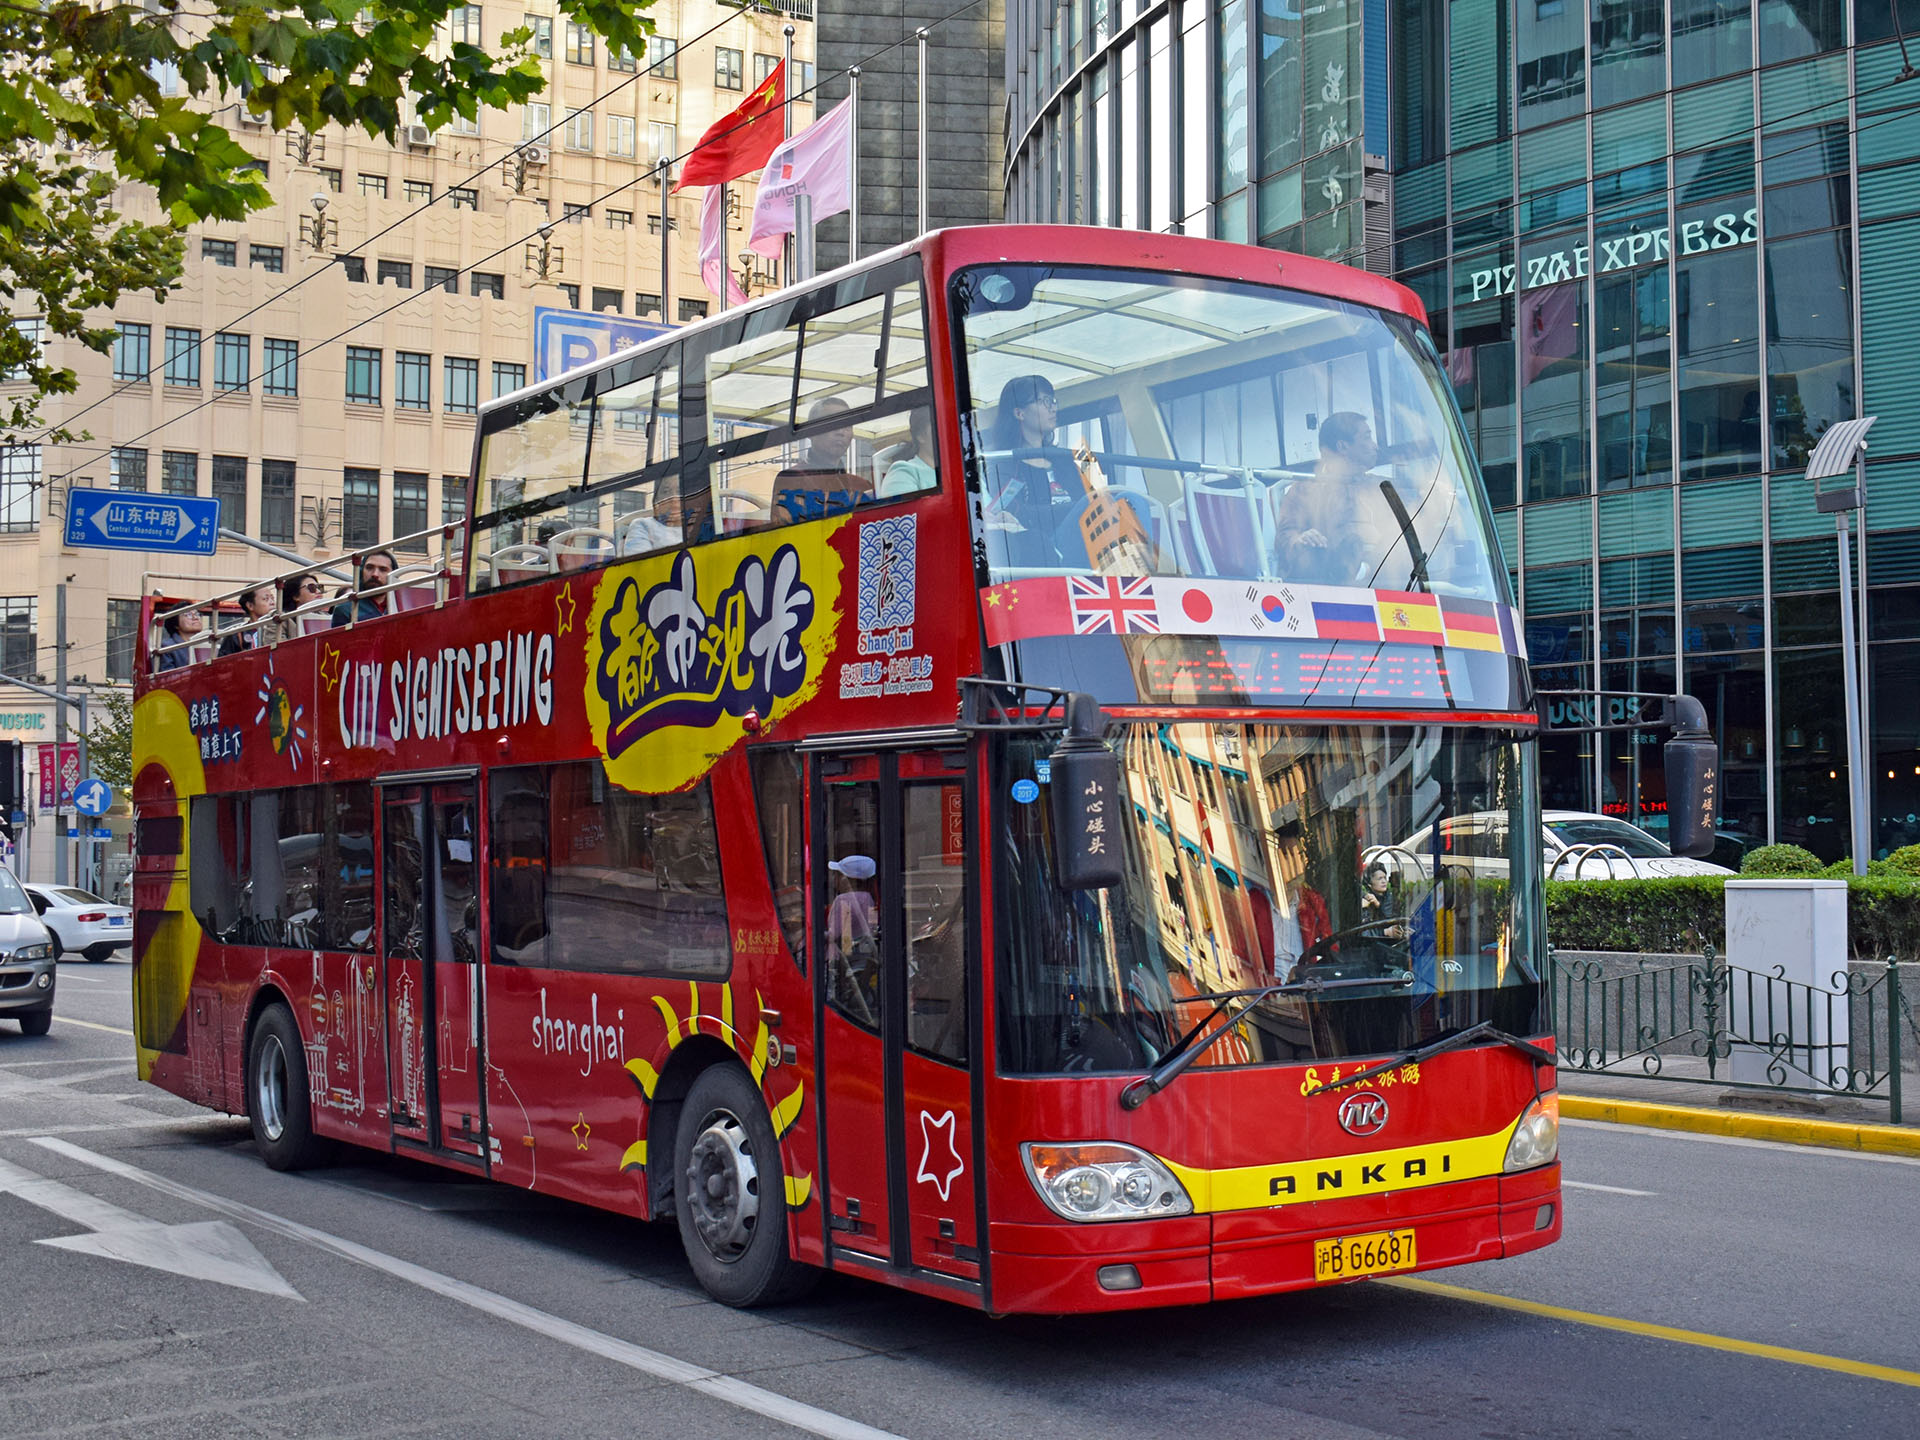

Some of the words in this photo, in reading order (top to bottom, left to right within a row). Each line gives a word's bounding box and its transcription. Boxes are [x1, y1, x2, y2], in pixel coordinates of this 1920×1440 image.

[75, 518, 83, 527] S
[109, 506, 177, 527] 山东中路
[201, 517, 210, 526] 北
[71, 531, 86, 540] 329
[108, 524, 131, 533] Central
[133, 526, 163, 536] Shandong
[165, 528, 175, 537] Rd.
[200, 527, 209, 536] N
[197, 540, 210, 549] 311
[606, 551, 811, 713] 都市观光
[858, 628, 913, 655] Shanghai
[339, 659, 382, 750] CITY
[389, 629, 553, 742] SIGHTSEEING
[840, 685, 854, 697] More
[855, 684, 882, 697] Discovery
[884, 682, 899, 694] More
[900, 680, 932, 694] Experience
[191, 699, 219, 728] 各站点
[202, 731, 241, 760] 随意上下
[1701, 767, 1715, 828] 小心碰头
[1085, 780, 1106, 855] 小心碰头
[532, 987, 625, 1077] shanghai
[1268, 1154, 1451, 1197] ANKAI
